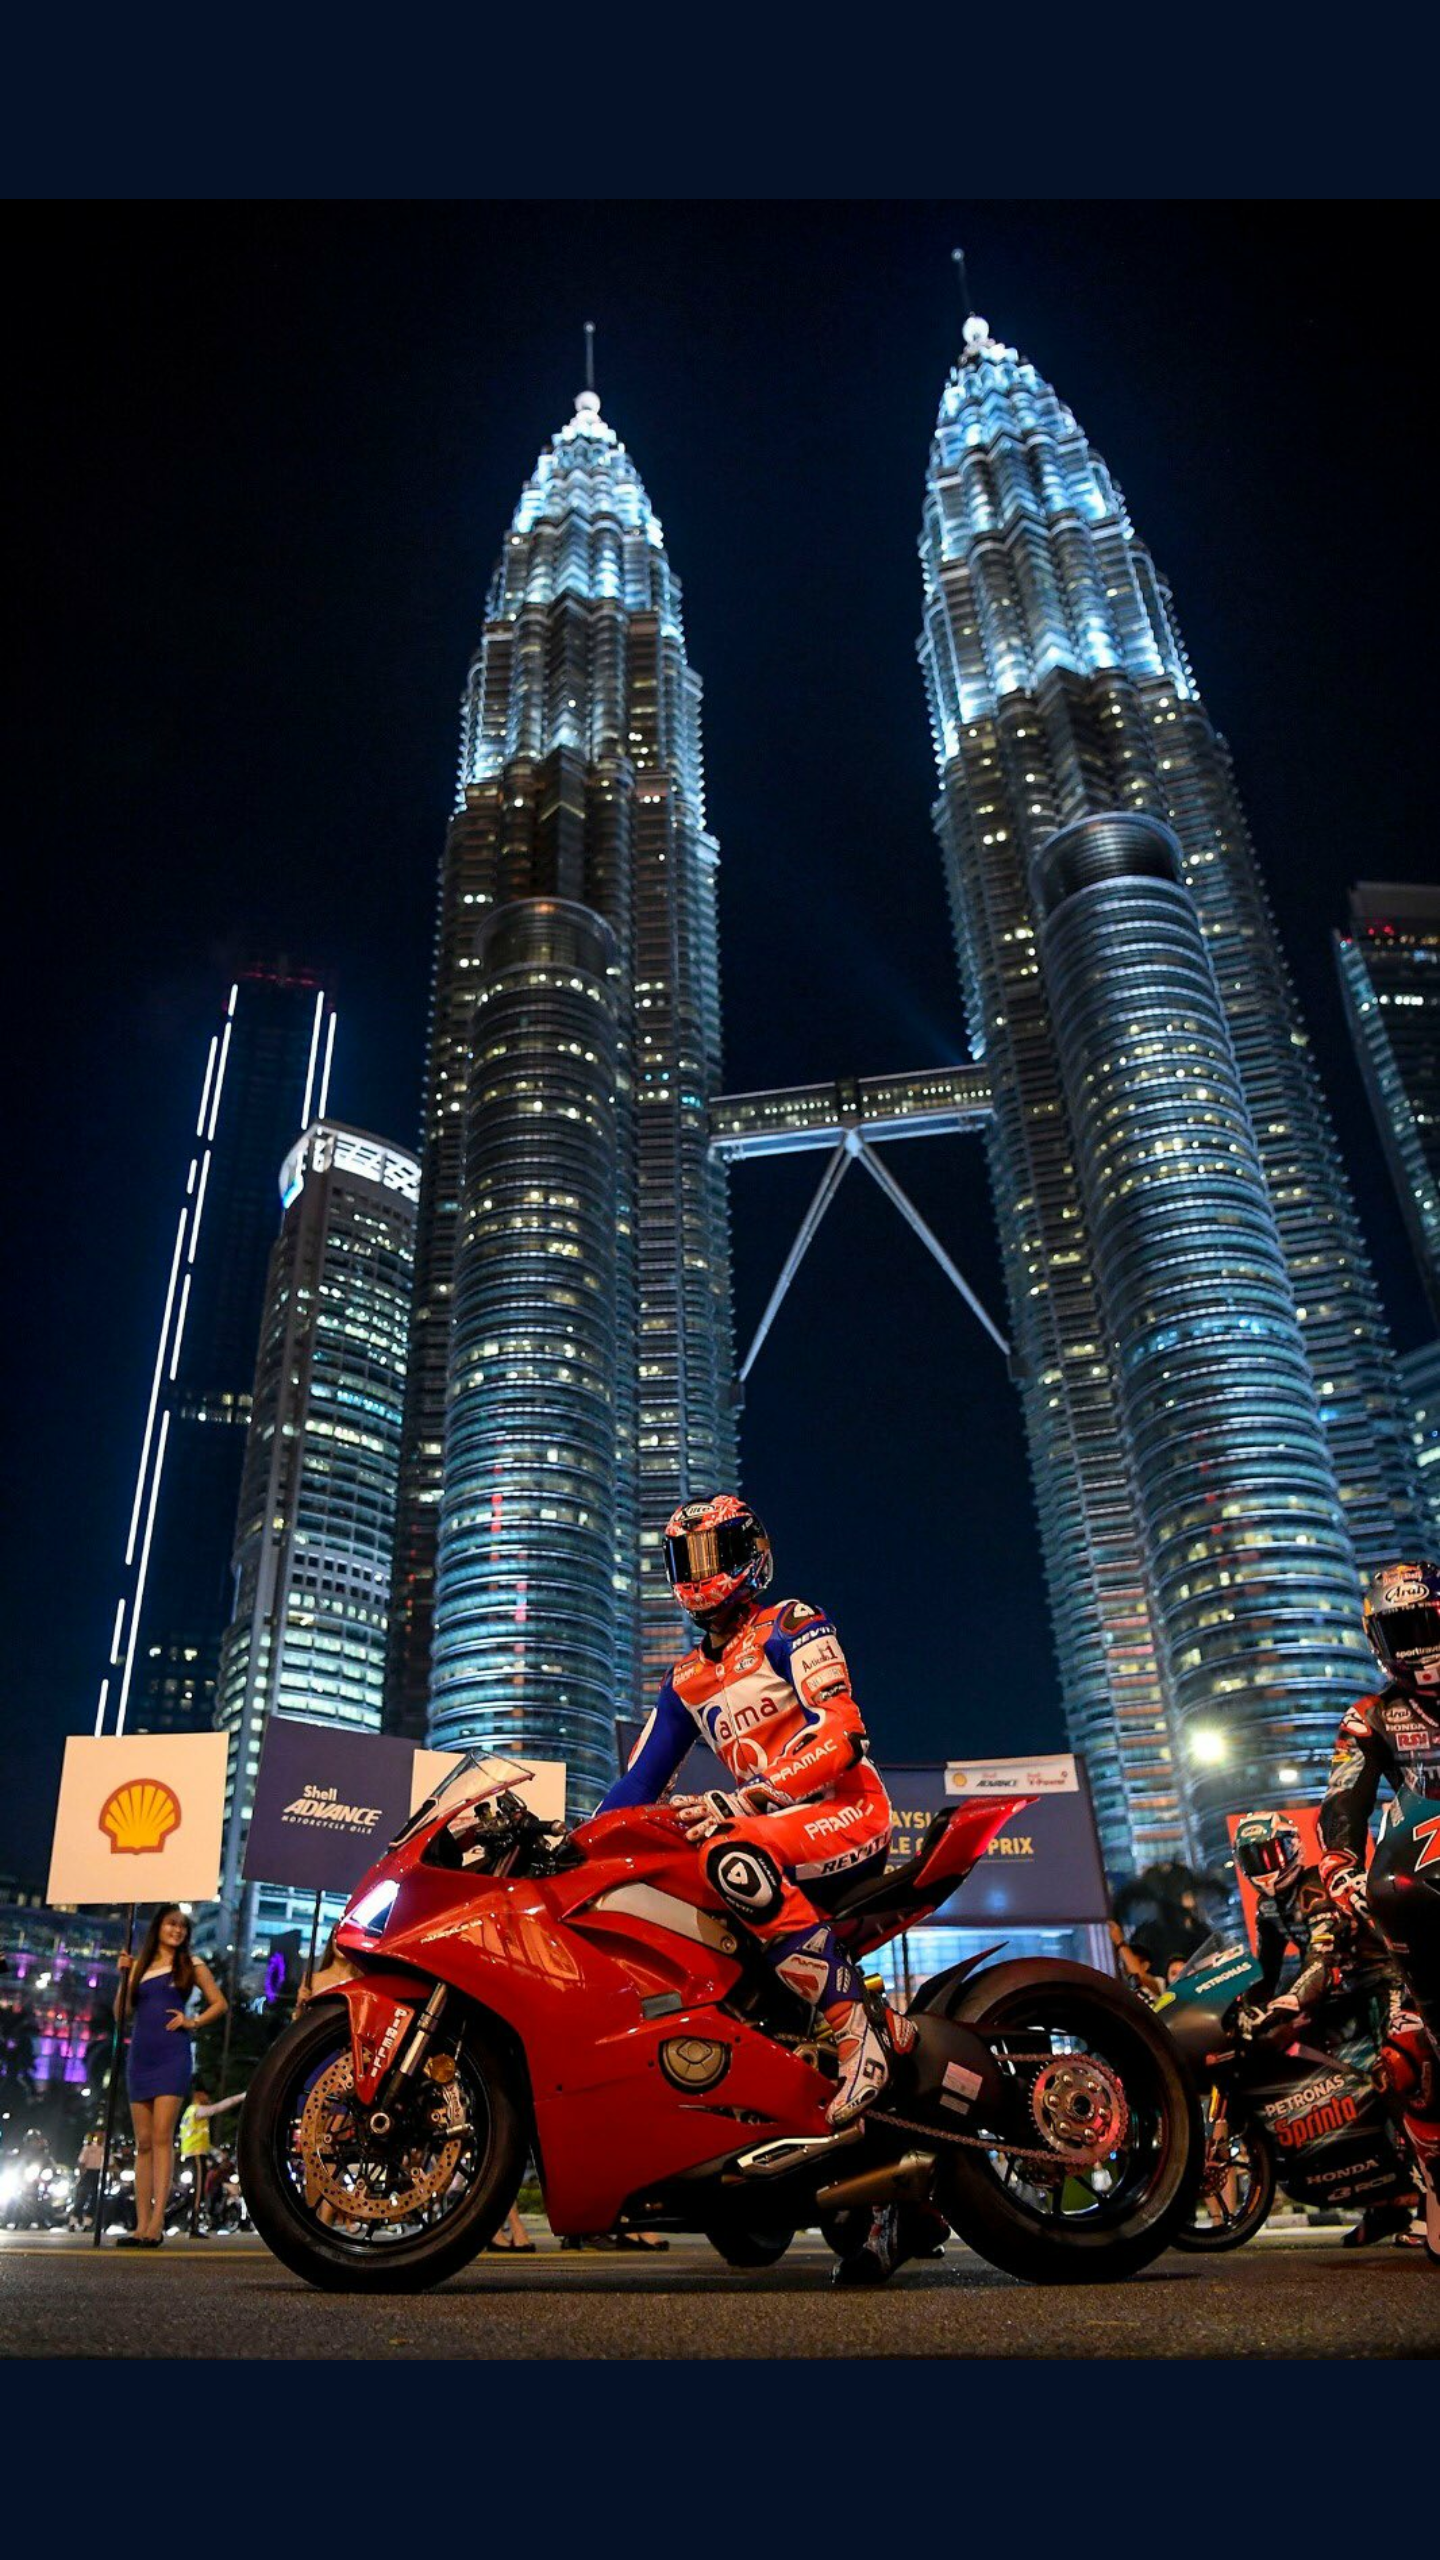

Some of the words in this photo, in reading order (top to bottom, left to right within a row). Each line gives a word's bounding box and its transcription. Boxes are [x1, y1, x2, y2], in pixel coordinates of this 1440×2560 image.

[1386, 1723, 1426, 1732] HONDA
[769, 1738, 838, 1784] PRAMAC
[303, 1784, 338, 1801] Shell
[281, 1815, 346, 1831] MOTORCYCLE
[349, 1826, 373, 1835] OILS
[283, 1798, 383, 1827] ADVANCE
[891, 1811, 938, 1829] AYSI
[889, 1837, 911, 1855] LE
[988, 1837, 1034, 1855] PRIX
[1195, 1961, 1252, 1993] PETRONAS
[370, 2007, 407, 2078] PIRELLI
[1265, 2073, 1345, 2117] PETRONAS
[1274, 2095, 1358, 2148] Sprinta
[1306, 2159, 1379, 2185] HONDA
